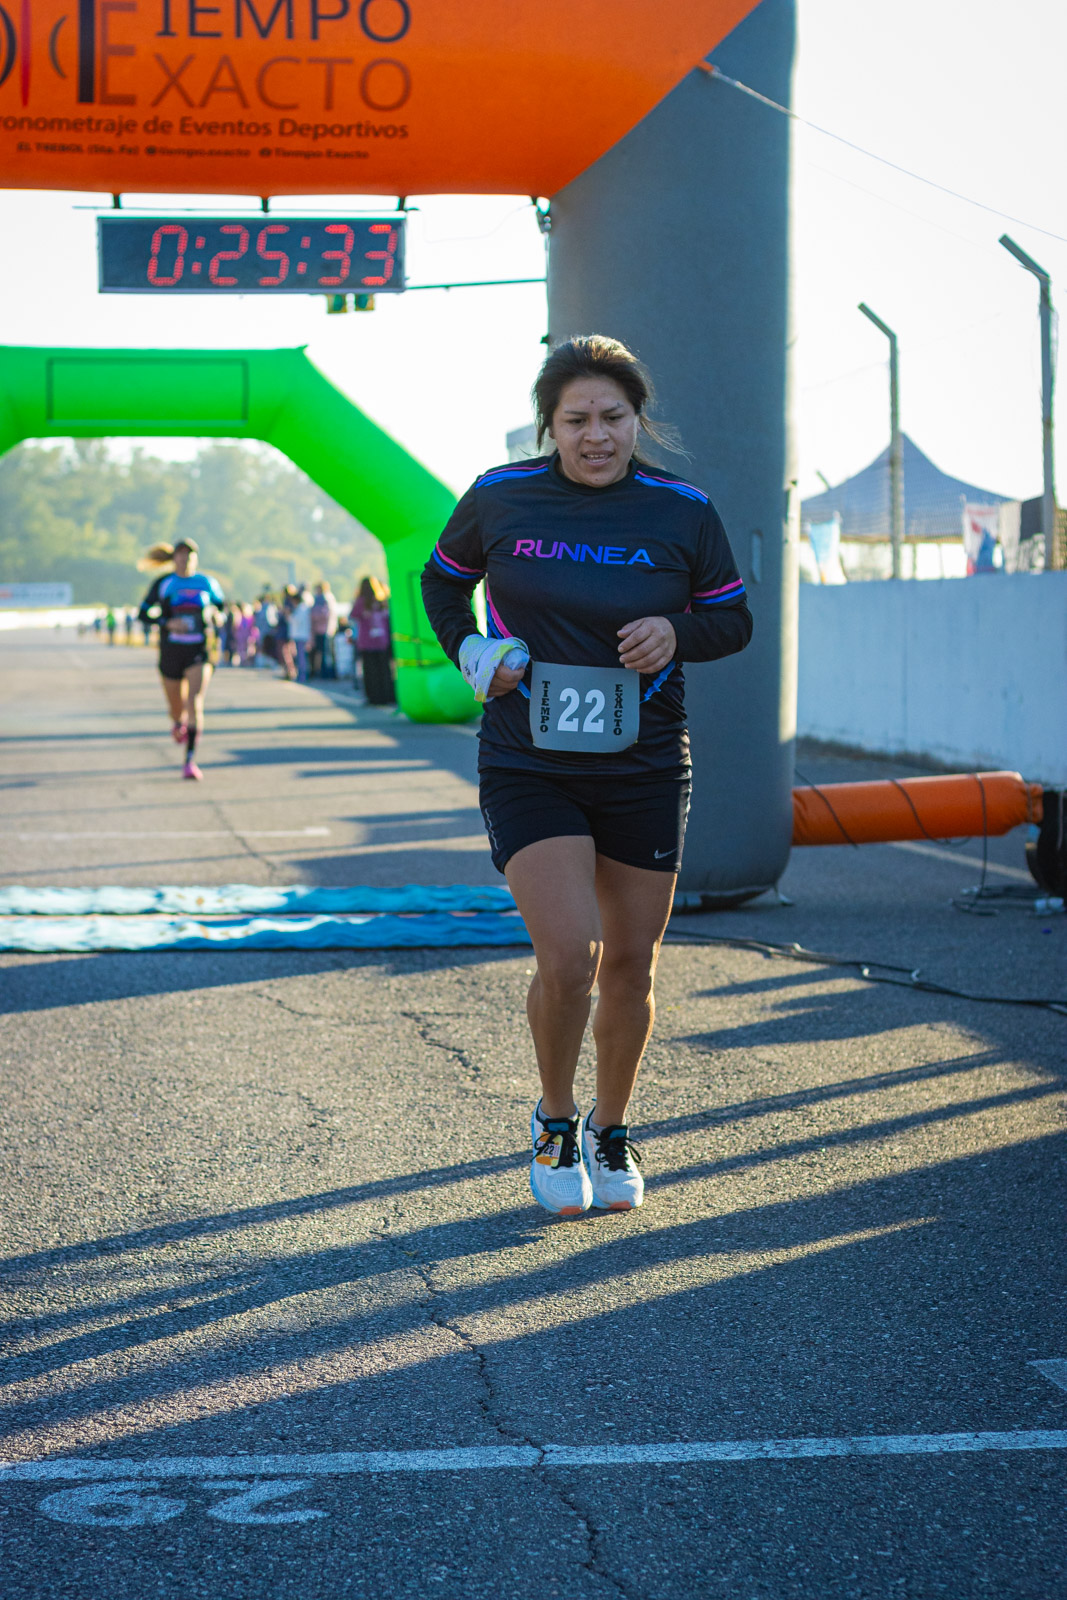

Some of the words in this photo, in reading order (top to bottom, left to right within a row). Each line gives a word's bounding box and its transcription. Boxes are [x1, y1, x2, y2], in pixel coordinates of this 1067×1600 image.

[143, 115, 173, 134] de
[179, 116, 272, 137] Eventos
[278, 117, 409, 141] Deportivos
[147, 224, 398, 287] 0:25:33
[512, 539, 656, 567] RUNNEA
[539, 680, 551, 733] TIEMPO
[557, 687, 606, 733] 22
[613, 683, 624, 736] EXACTO
